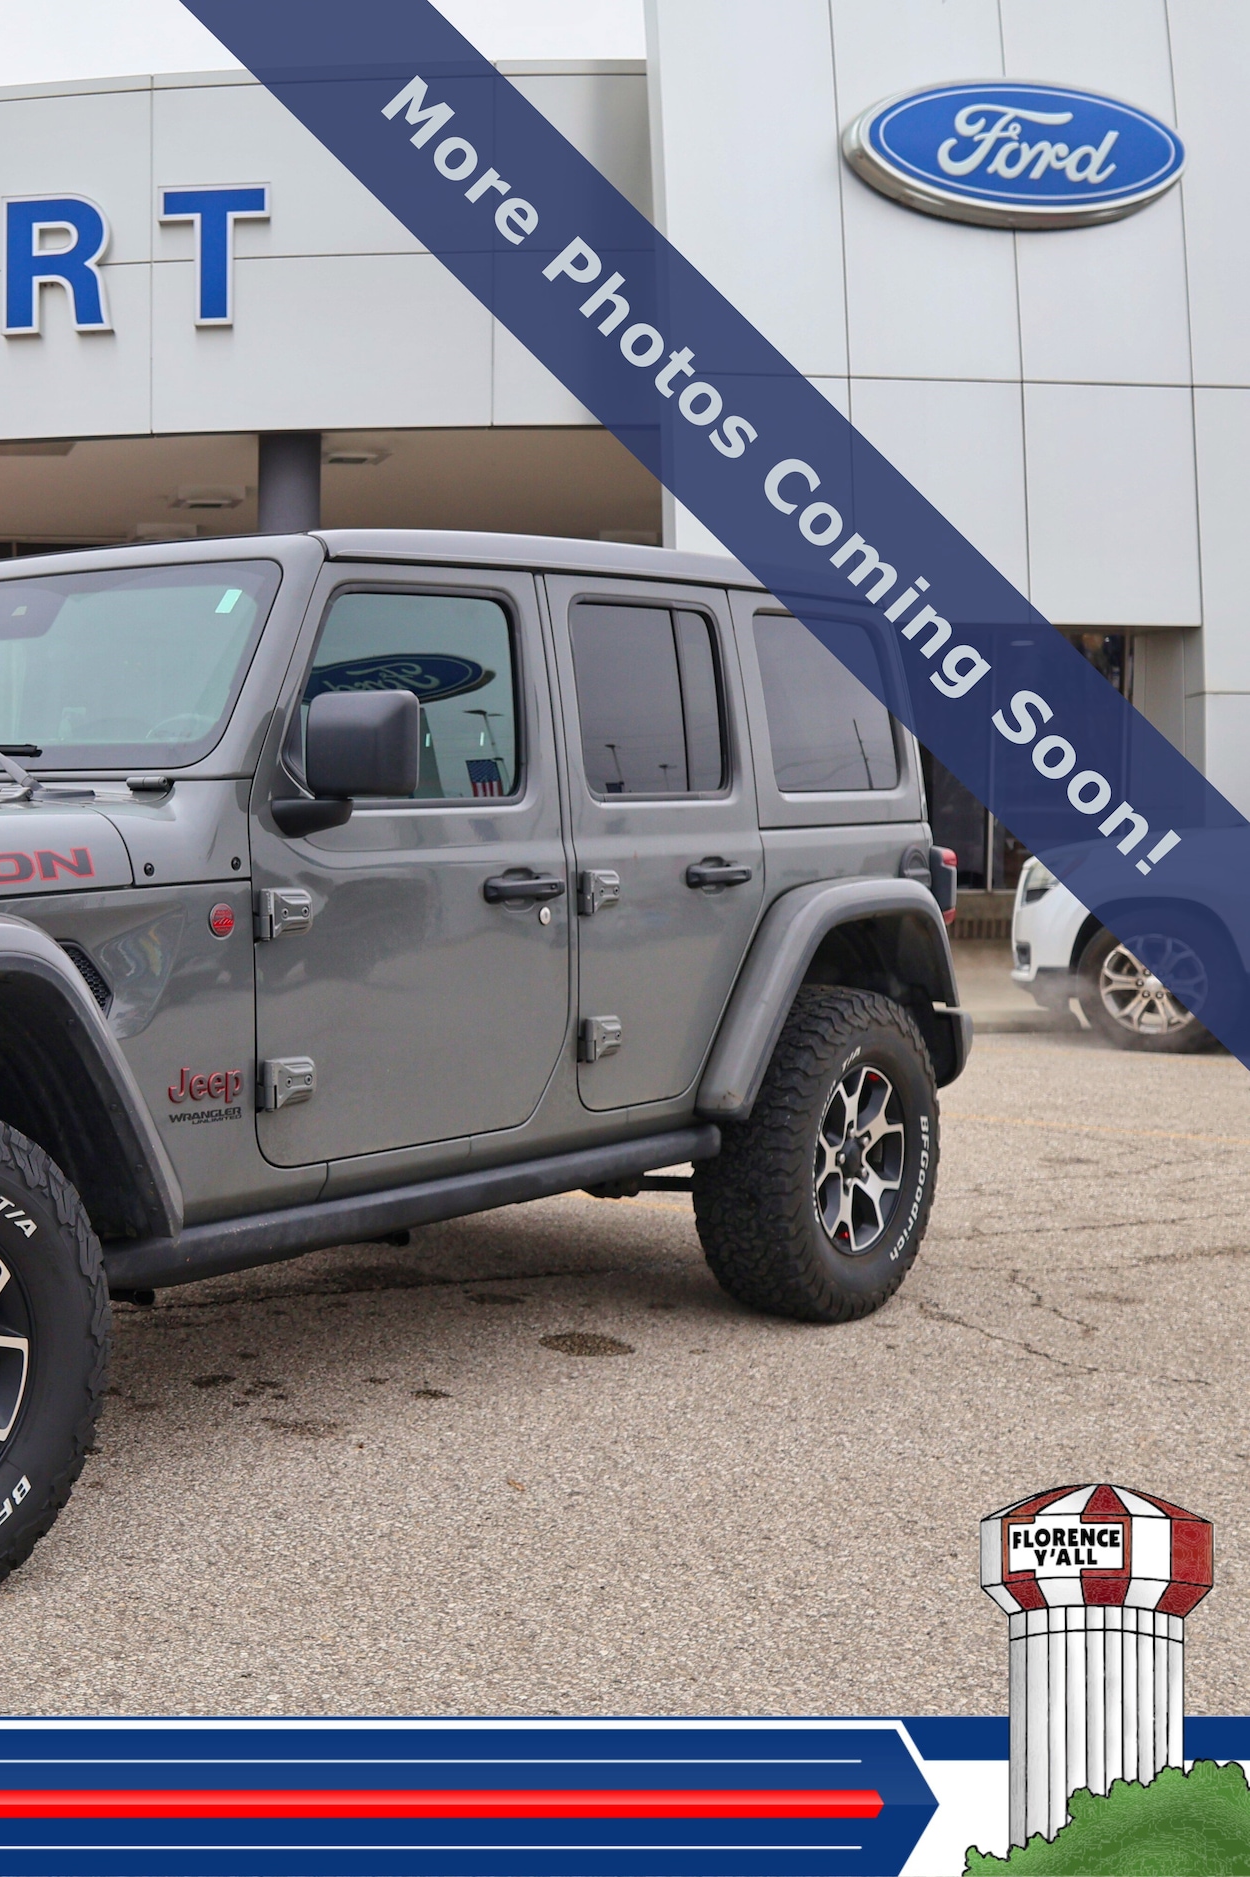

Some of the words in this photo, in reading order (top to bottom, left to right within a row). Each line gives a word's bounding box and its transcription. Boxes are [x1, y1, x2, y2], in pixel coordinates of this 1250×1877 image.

[937, 103, 1119, 184] Ford
[168, 1067, 244, 1103] Jeep
[169, 1106, 241, 1123] WRANGLER
[191, 1114, 242, 1125] UNLIMITED
[889, 1114, 930, 1262] BFGoodrich
